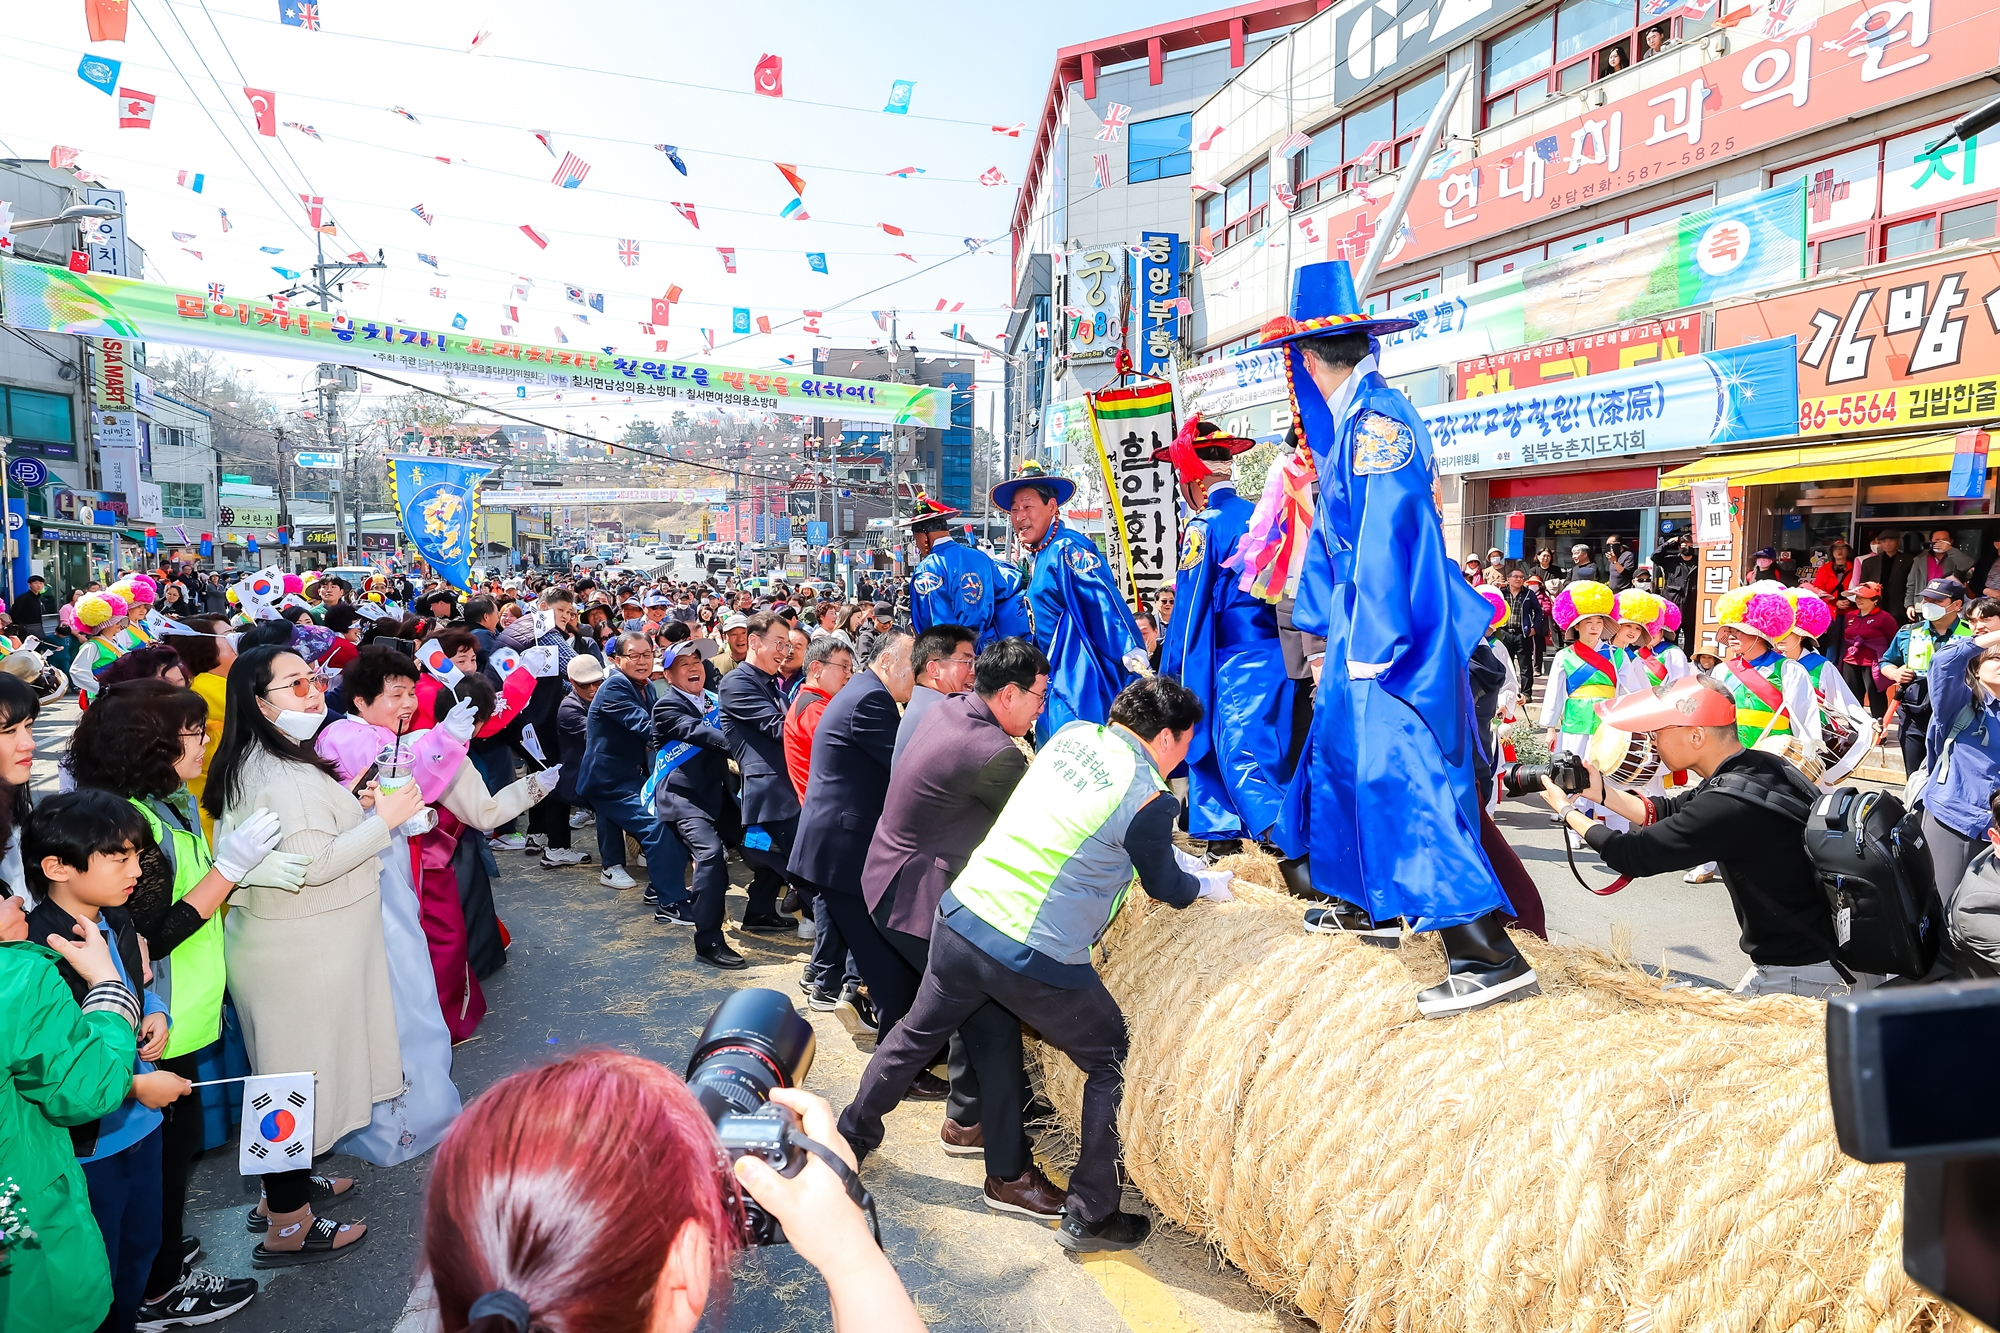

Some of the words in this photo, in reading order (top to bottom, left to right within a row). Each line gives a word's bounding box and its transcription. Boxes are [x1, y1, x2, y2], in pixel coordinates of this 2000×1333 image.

[1438, 0, 1931, 229] 현대치과의원
[1708, 228, 1740, 262] 축
[1077, 251, 1116, 307] 궁
[175, 293, 310, 336] 모이자!
[721, 370, 790, 397] 발전을
[800, 379, 876, 405] 위하여!
[1799, 271, 2000, 386] 김밥
[104, 365, 125, 405] MART
[1437, 453, 1480, 468] 리기위원회
[1521, 430, 1646, 463] 칠북농촌지도자회
